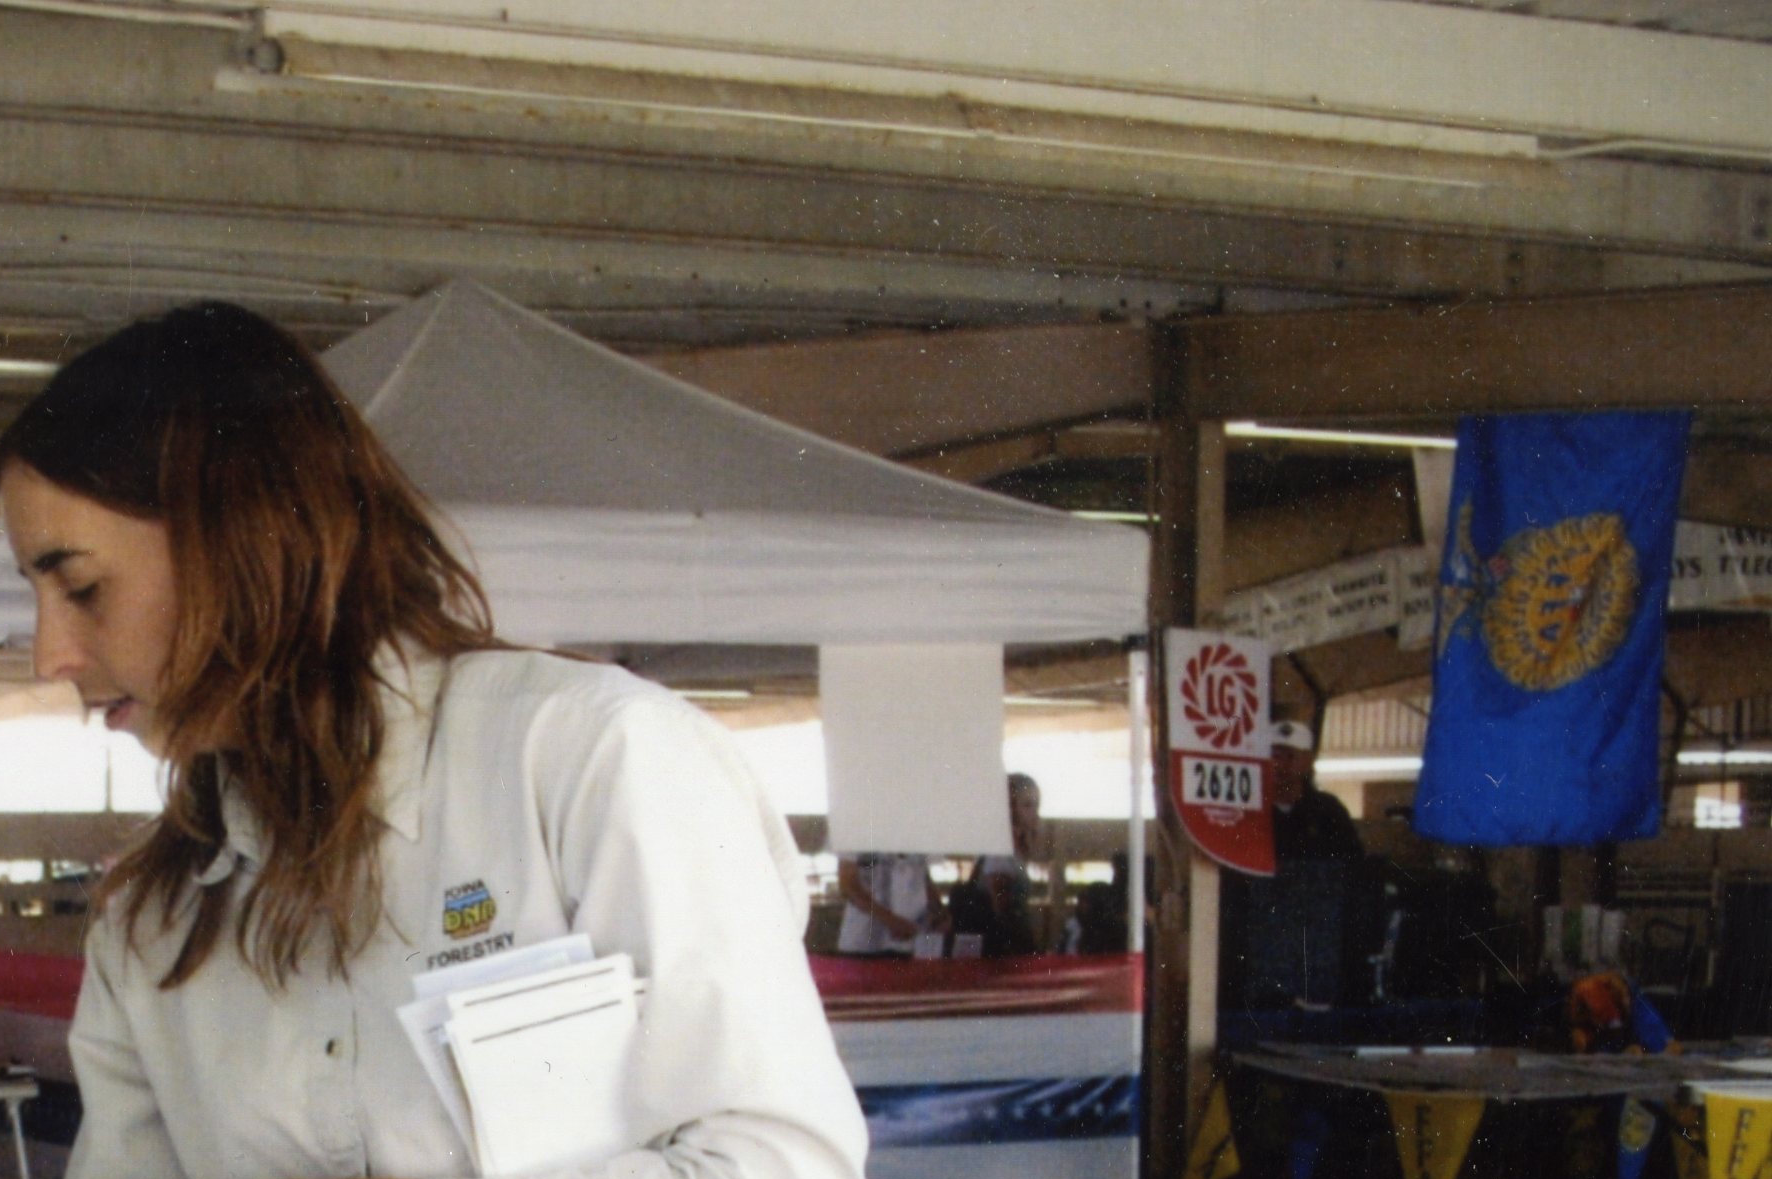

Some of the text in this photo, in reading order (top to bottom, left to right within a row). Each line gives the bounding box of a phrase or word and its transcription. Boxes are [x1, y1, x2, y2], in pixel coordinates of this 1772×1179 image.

[1206, 674, 1238, 719] LG
[1193, 762, 1251, 803] 2620
[427, 932, 515, 971] FORESTRY
